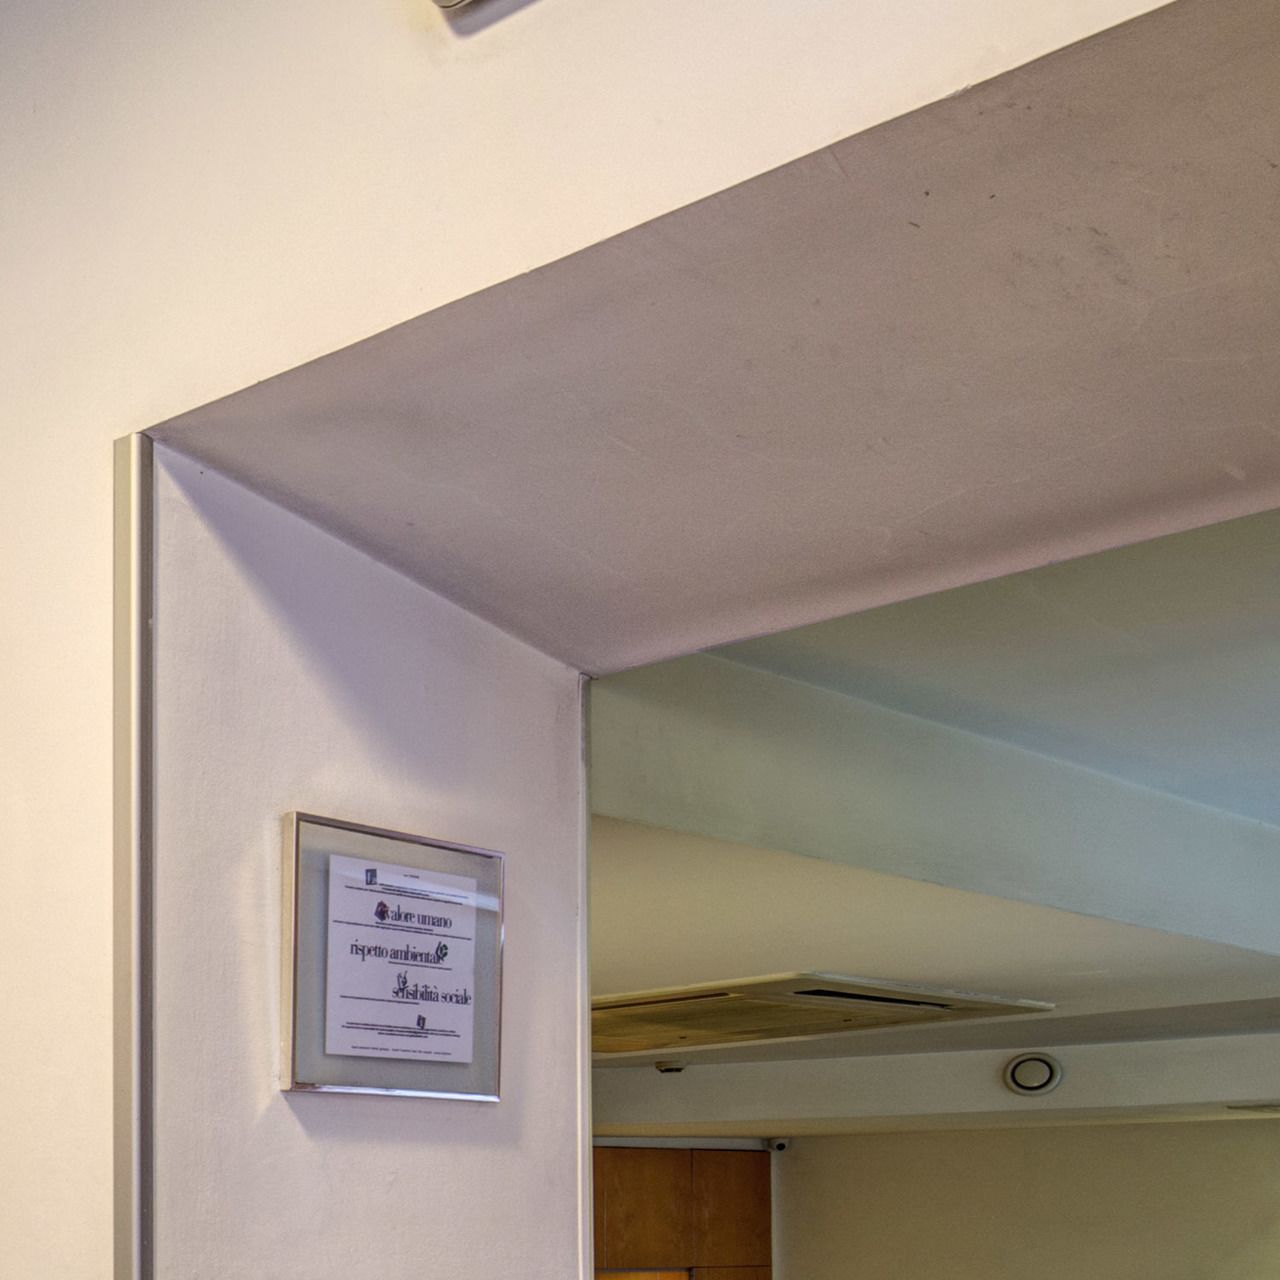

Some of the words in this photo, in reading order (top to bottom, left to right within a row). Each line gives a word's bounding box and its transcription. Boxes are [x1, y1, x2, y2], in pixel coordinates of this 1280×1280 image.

[417, 914, 452, 928] umano
[350, 938, 389, 961] rispetto
[392, 983, 439, 1003] sensibilità
[441, 988, 472, 1006] sociale
